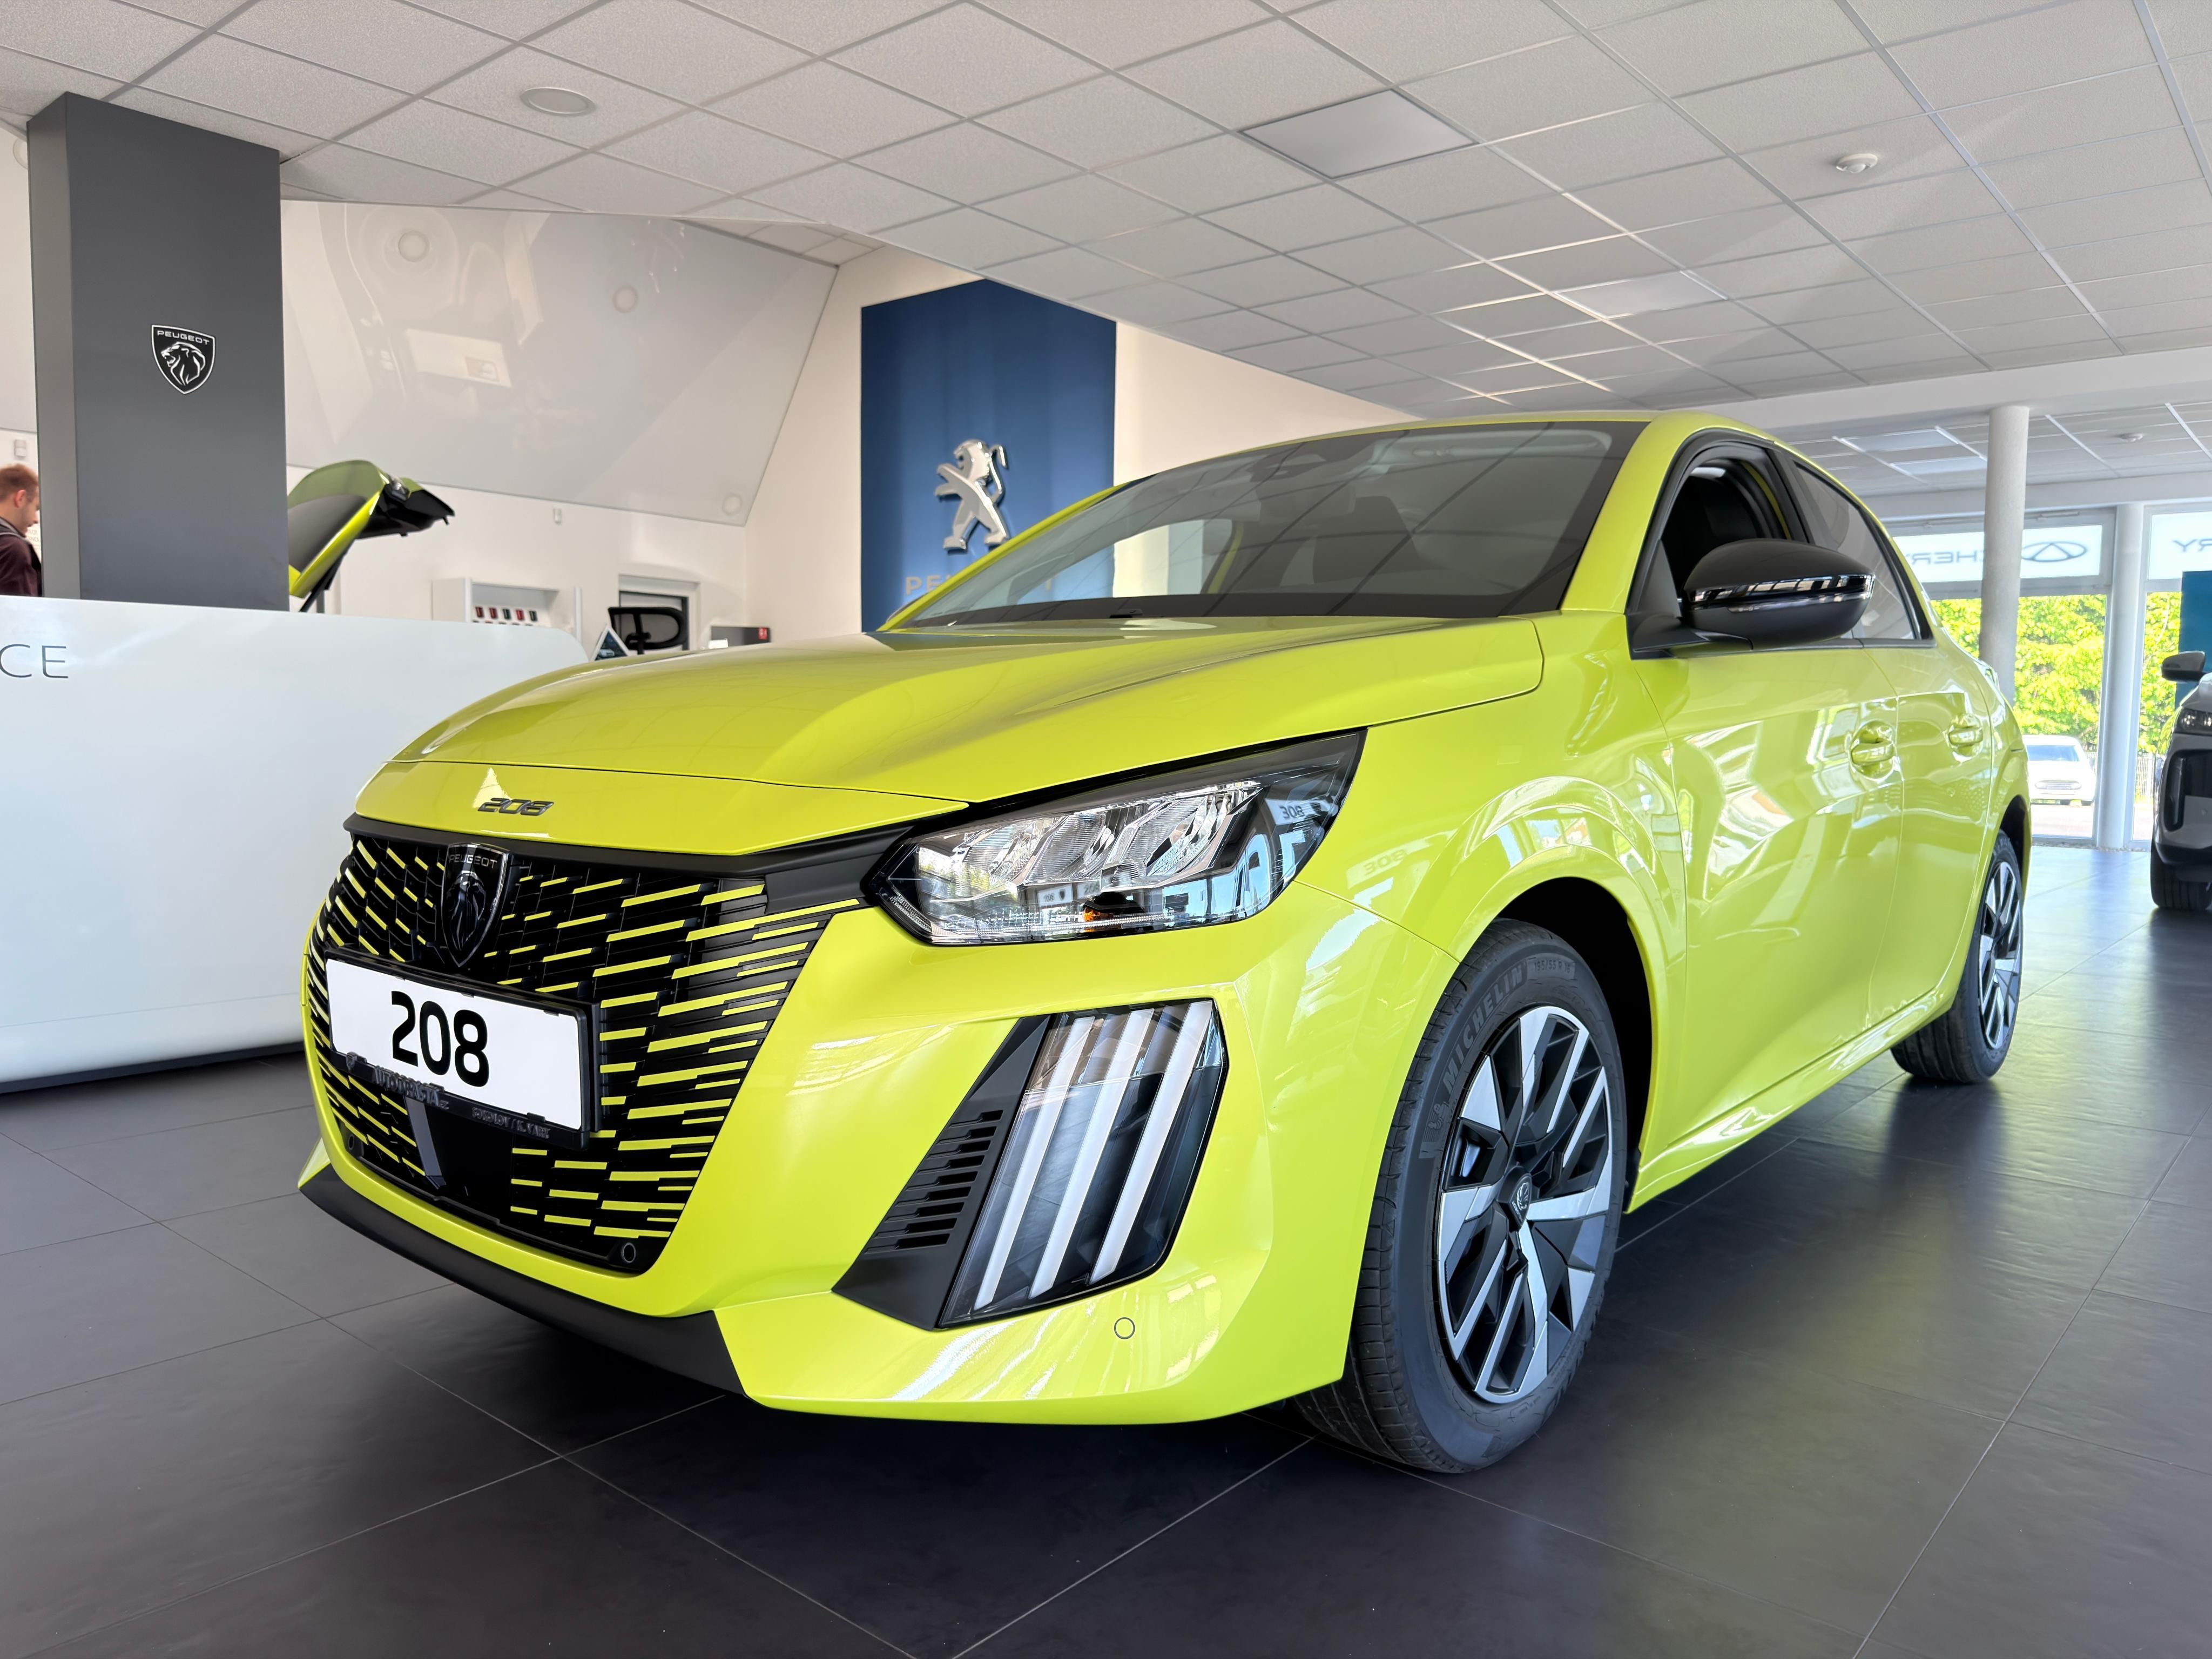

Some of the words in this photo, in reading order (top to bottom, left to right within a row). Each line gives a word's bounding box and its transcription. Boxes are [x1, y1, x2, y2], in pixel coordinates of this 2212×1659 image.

[157, 329, 210, 345] PEUGEOT
[0, 644, 69, 678] CE
[477, 797, 554, 816] 208
[449, 854, 498, 868] PEUGEOT
[391, 990, 490, 1087] 208
[1442, 964, 1523, 1095] MICHELIN
